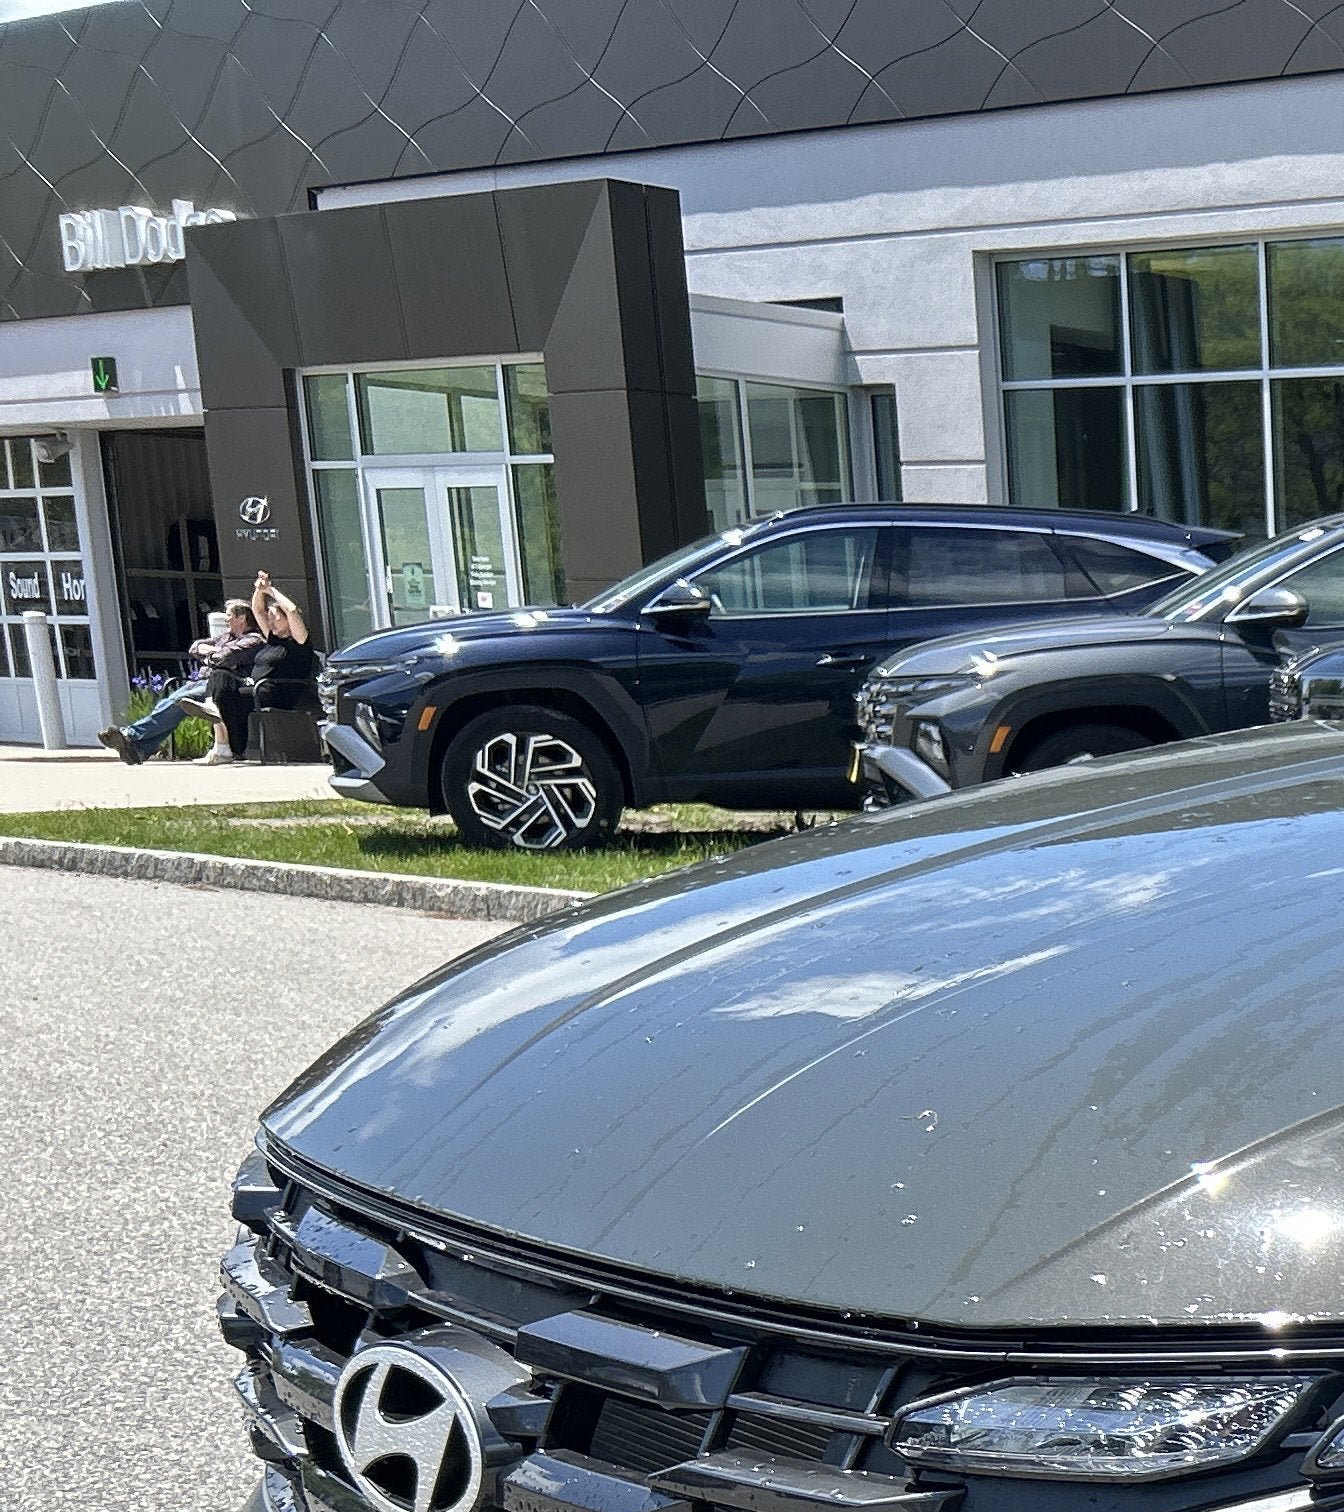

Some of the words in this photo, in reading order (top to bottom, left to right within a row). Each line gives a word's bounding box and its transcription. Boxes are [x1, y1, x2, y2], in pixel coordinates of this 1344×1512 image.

[58, 208, 124, 271] Bill
[119, 198, 237, 265] Dod
[9, 571, 41, 599] Sound
